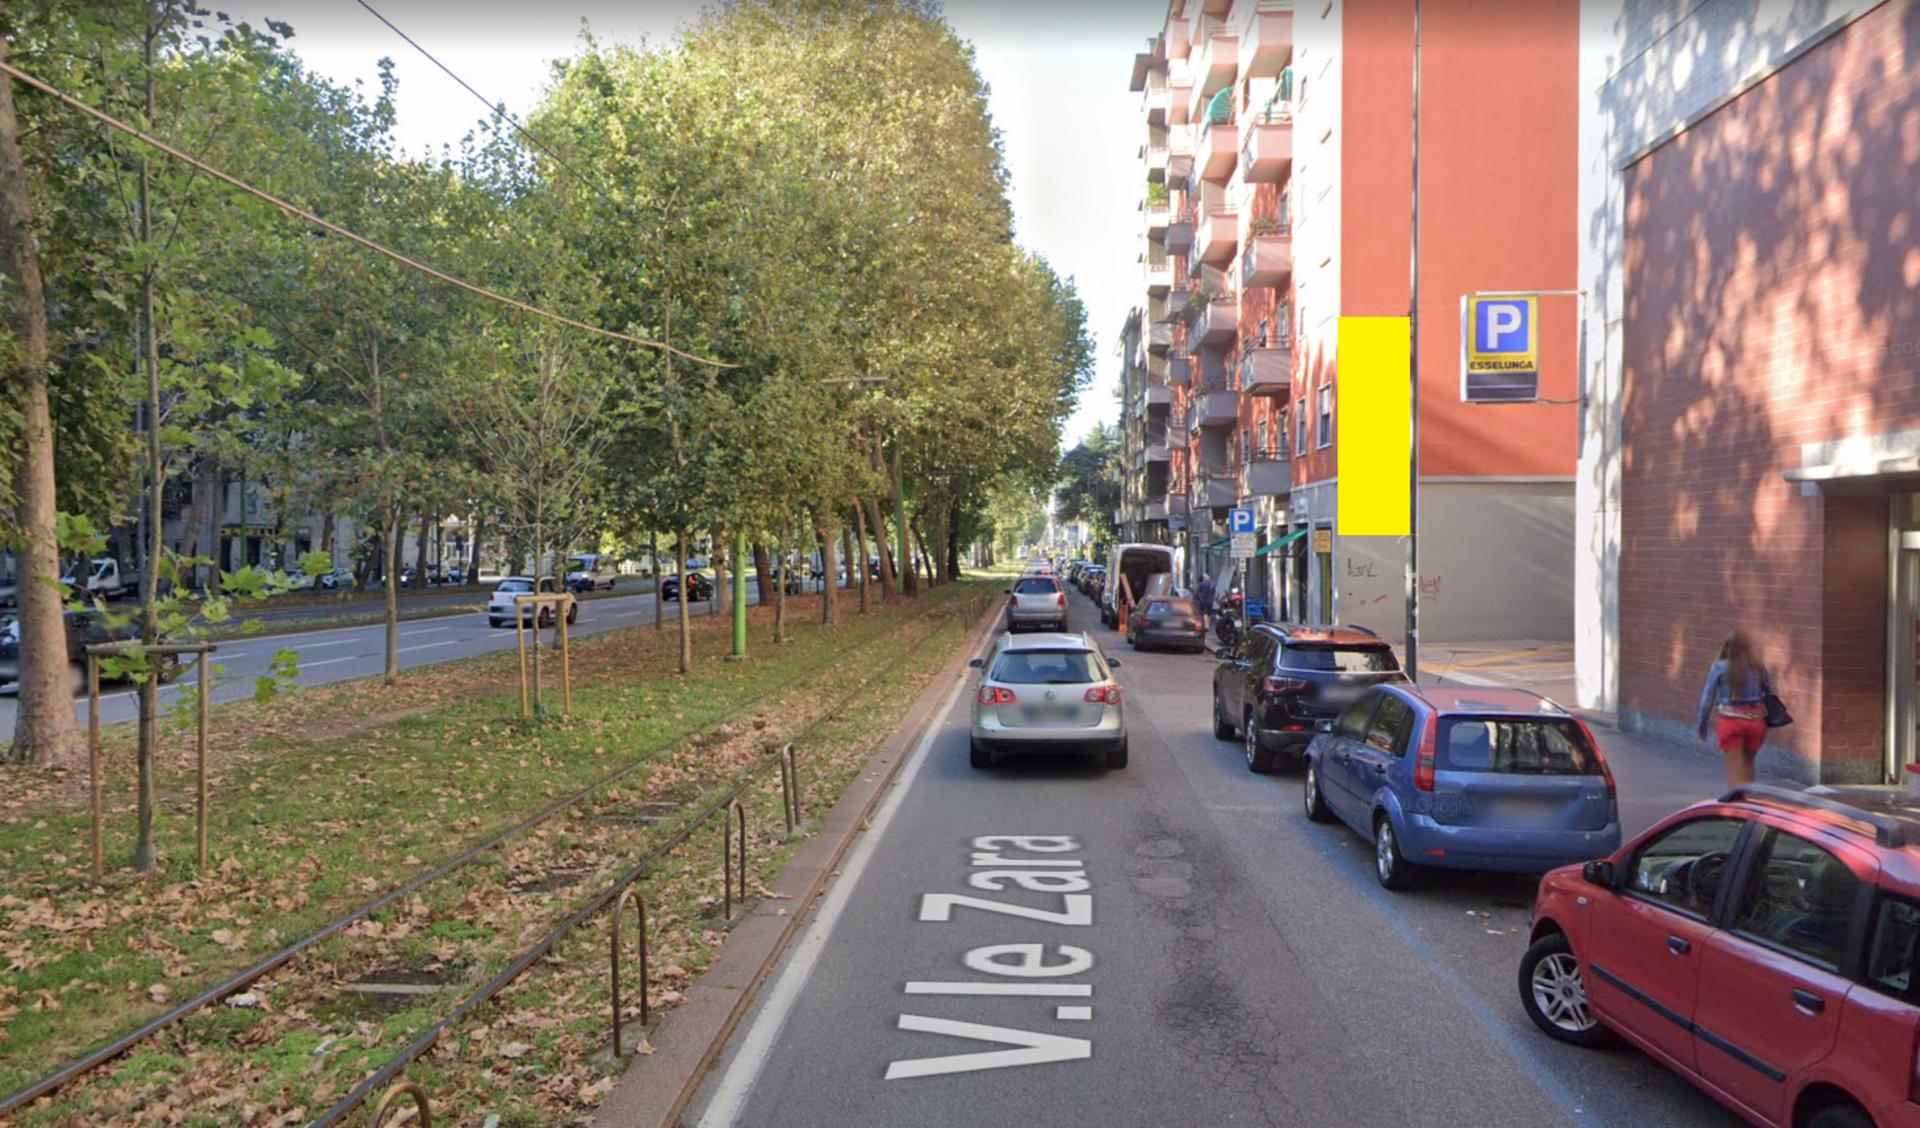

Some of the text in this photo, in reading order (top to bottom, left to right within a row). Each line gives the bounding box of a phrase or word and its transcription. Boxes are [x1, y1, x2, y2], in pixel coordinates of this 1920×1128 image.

[1487, 304, 1522, 349] P
[1469, 360, 1534, 370] ESSELUNGA
[1234, 511, 1250, 531] P
